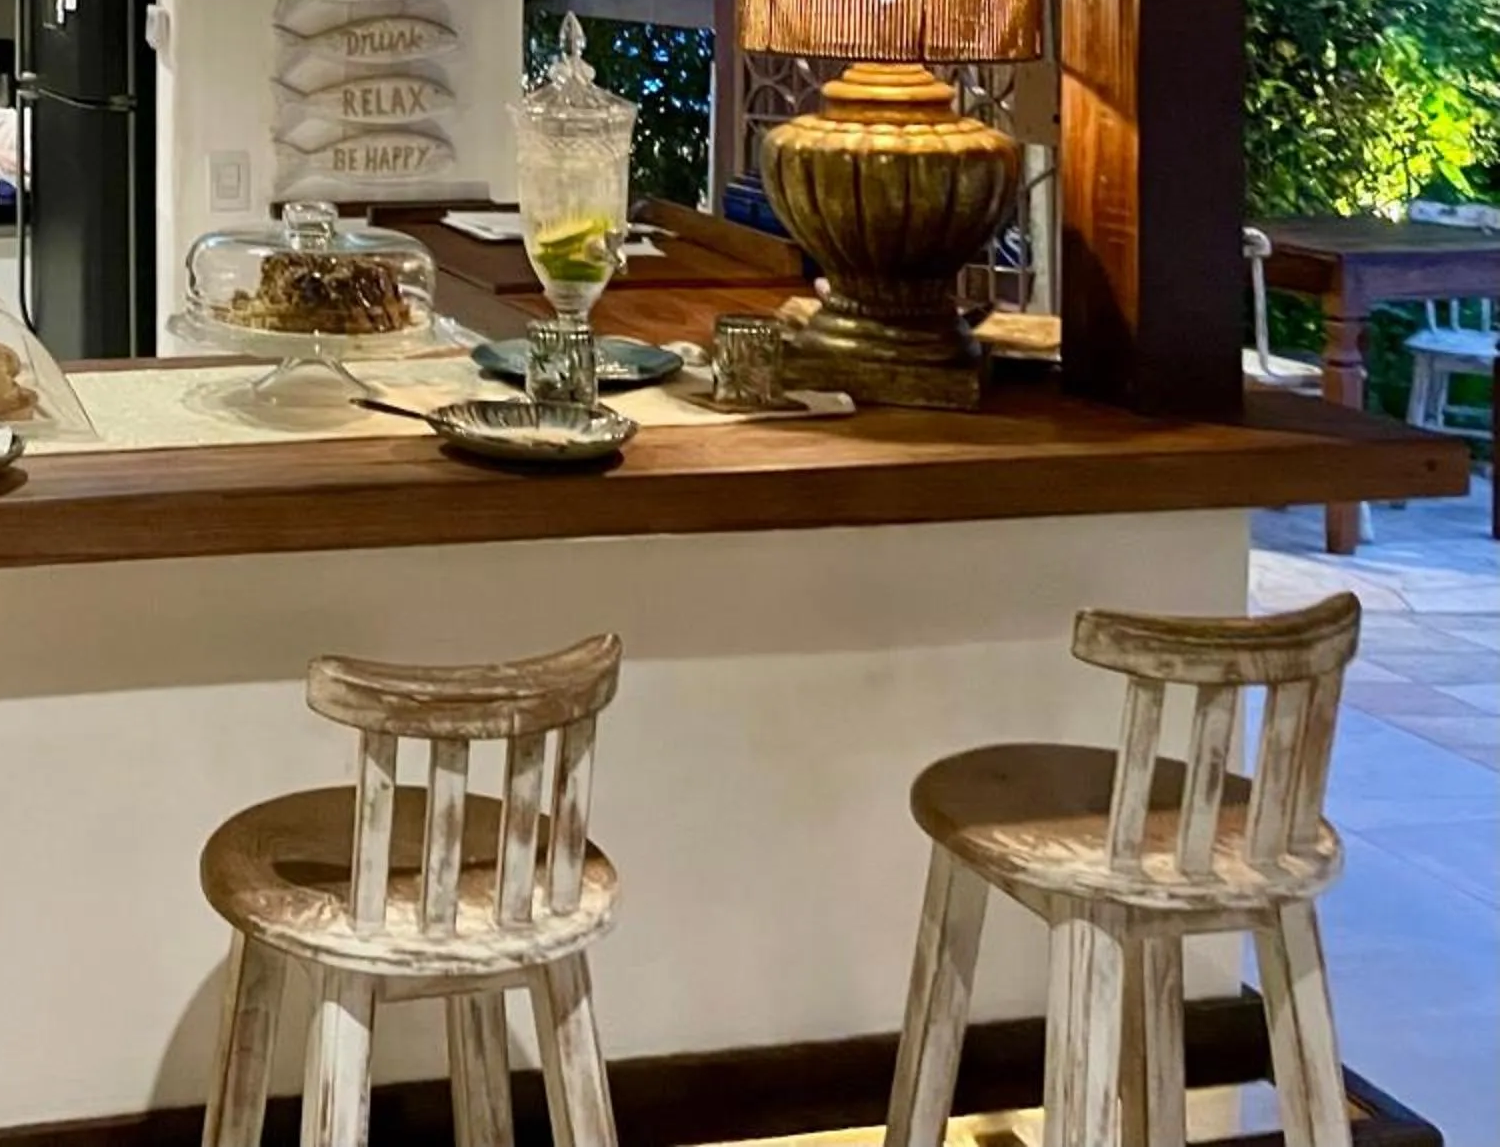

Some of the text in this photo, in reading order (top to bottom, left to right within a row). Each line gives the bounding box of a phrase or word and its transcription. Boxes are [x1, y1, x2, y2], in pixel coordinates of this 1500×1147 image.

[342, 85, 428, 118] RELAX
[332, 145, 431, 173] BE HAPPY
